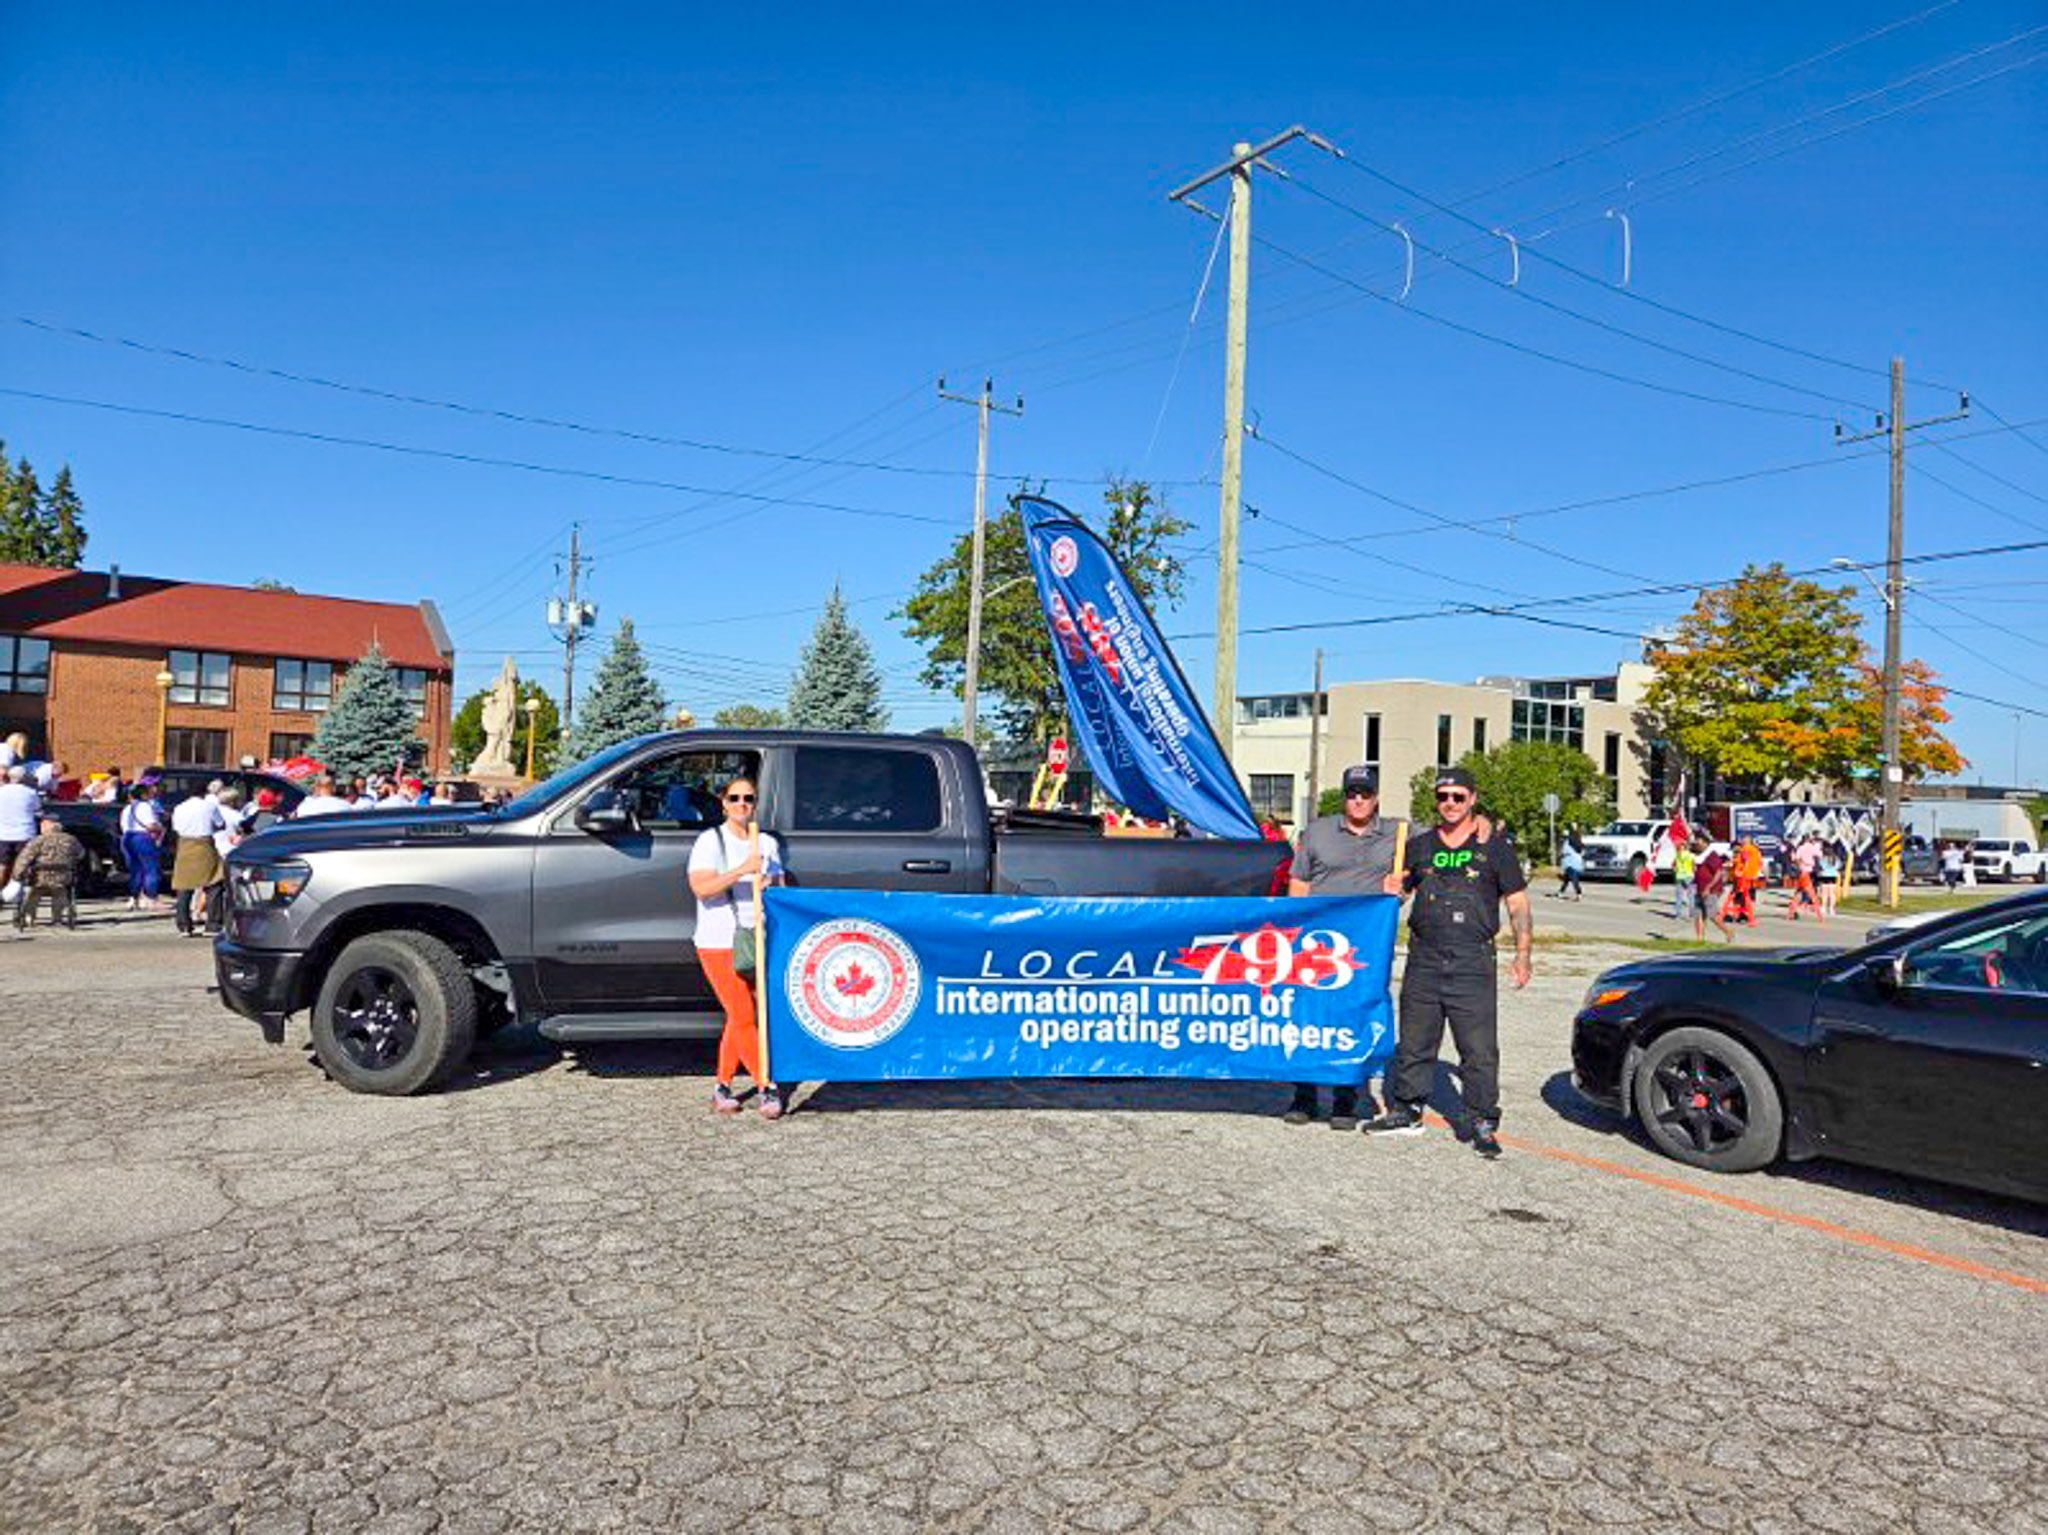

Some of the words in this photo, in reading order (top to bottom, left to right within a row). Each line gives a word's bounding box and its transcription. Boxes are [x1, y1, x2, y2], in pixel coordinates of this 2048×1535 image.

[1102, 616, 1121, 635] of
[1105, 579, 1149, 659] engineers
[1114, 634, 1145, 680] union
[1144, 655, 1190, 738] operating
[981, 950, 1174, 979] LOCAL
[1189, 929, 1353, 990] 793
[936, 983, 1150, 1014] international
[1158, 987, 1251, 1016] union
[1260, 988, 1295, 1018] of
[1019, 1013, 1180, 1050] operating
[1188, 1015, 1355, 1051] engineers
